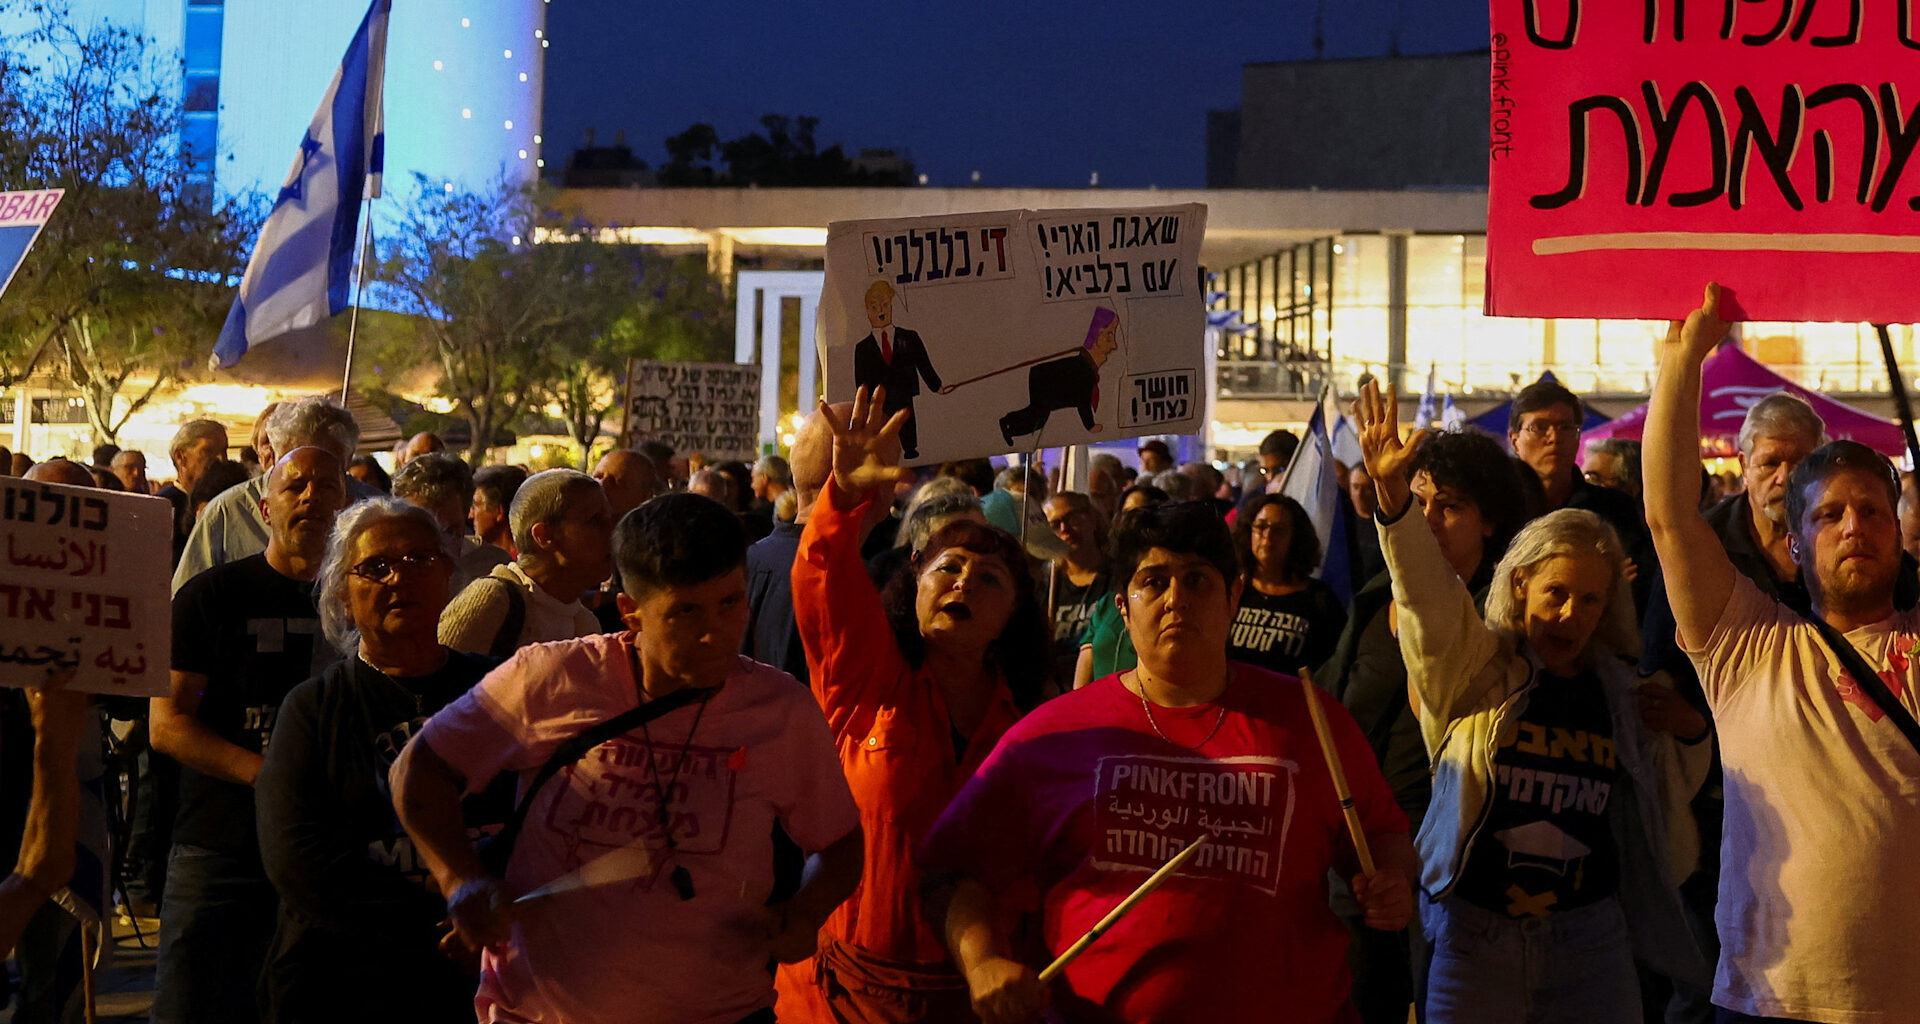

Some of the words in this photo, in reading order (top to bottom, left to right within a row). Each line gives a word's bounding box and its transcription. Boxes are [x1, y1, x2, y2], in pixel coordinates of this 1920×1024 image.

[1491, 32, 1516, 161] @pink.front
[1037, 220, 1101, 258] הארי!
[1108, 216, 1179, 250] שאגת
[872, 228, 971, 285] כלבלבי!
[1142, 258, 1177, 293] עם
[1134, 375, 1189, 400] חושך
[1131, 398, 1188, 423] נצחי!
[4, 485, 109, 531] כולנו
[70, 591, 132, 630] בני
[1111, 764, 1277, 808] PINKFRONT
[1496, 763, 1612, 816] האקדמי
[1108, 795, 1189, 830] الوردية
[1197, 807, 1273, 842] الجبهة
[1106, 829, 1186, 863] הורודה
[1194, 841, 1270, 879] החזית
